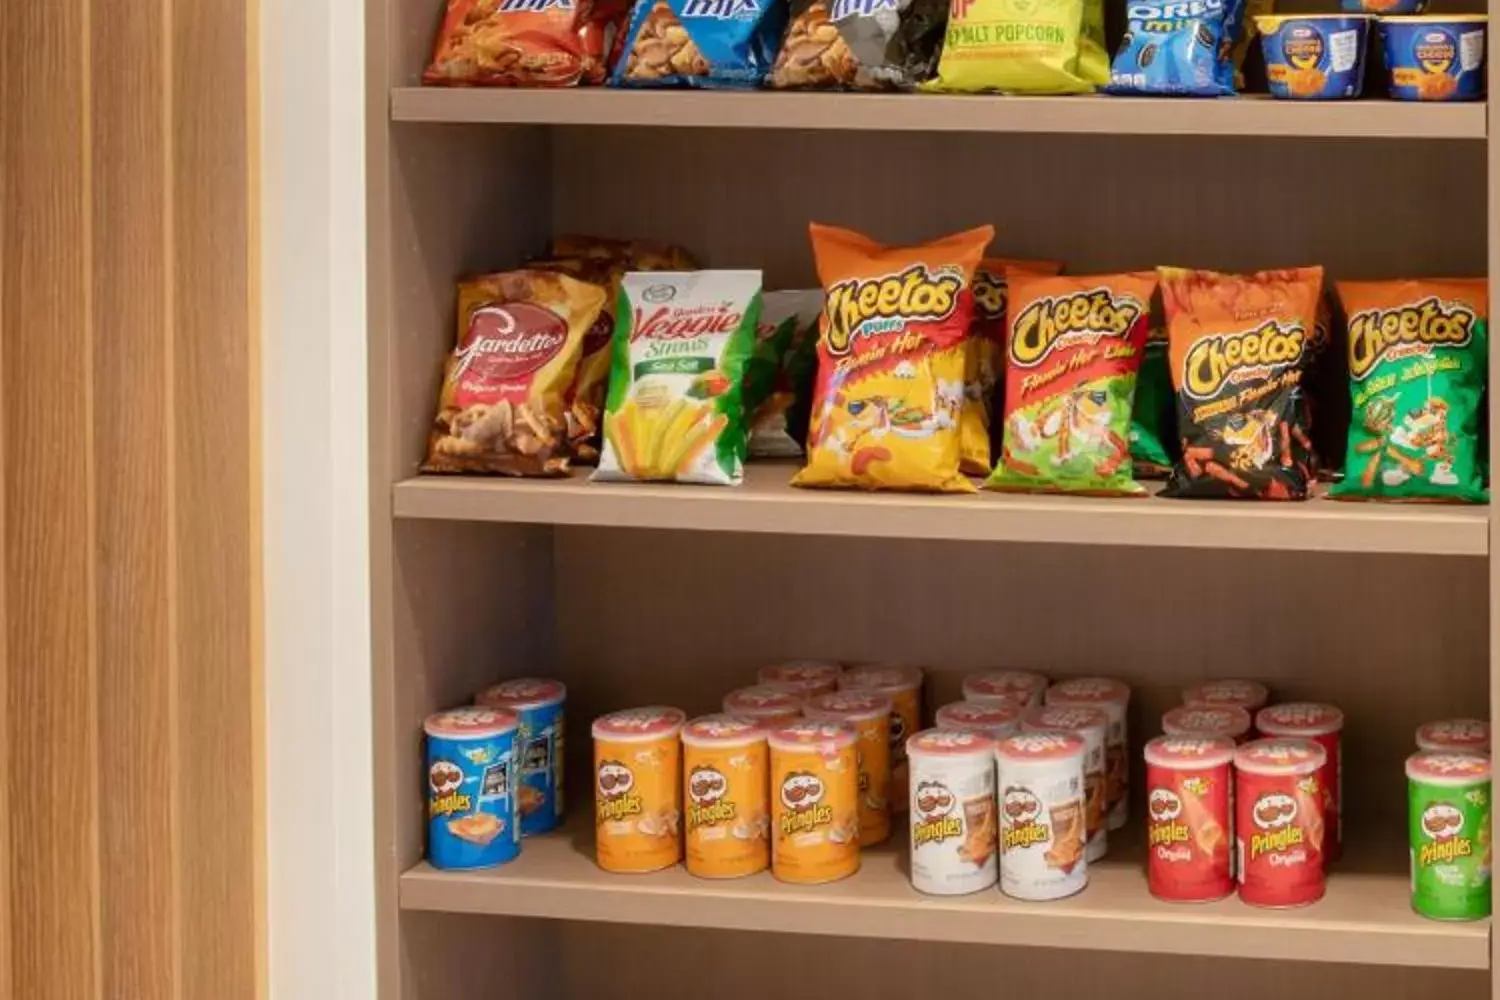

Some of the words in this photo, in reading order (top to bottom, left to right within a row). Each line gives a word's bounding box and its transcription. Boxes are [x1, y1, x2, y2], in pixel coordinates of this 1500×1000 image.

[994, 24, 1065, 44] POPCORN
[629, 306, 741, 344] Veggie
[826, 265, 962, 352] Cheetos
[1011, 289, 1139, 365] Cheetos
[645, 339, 709, 358] Straws
[1348, 298, 1472, 379] Cheetos
[1184, 320, 1306, 399] Cheetos
[780, 805, 832, 834] Pringles
[1252, 823, 1304, 859] Pringles
[1420, 836, 1472, 868] Pringles
